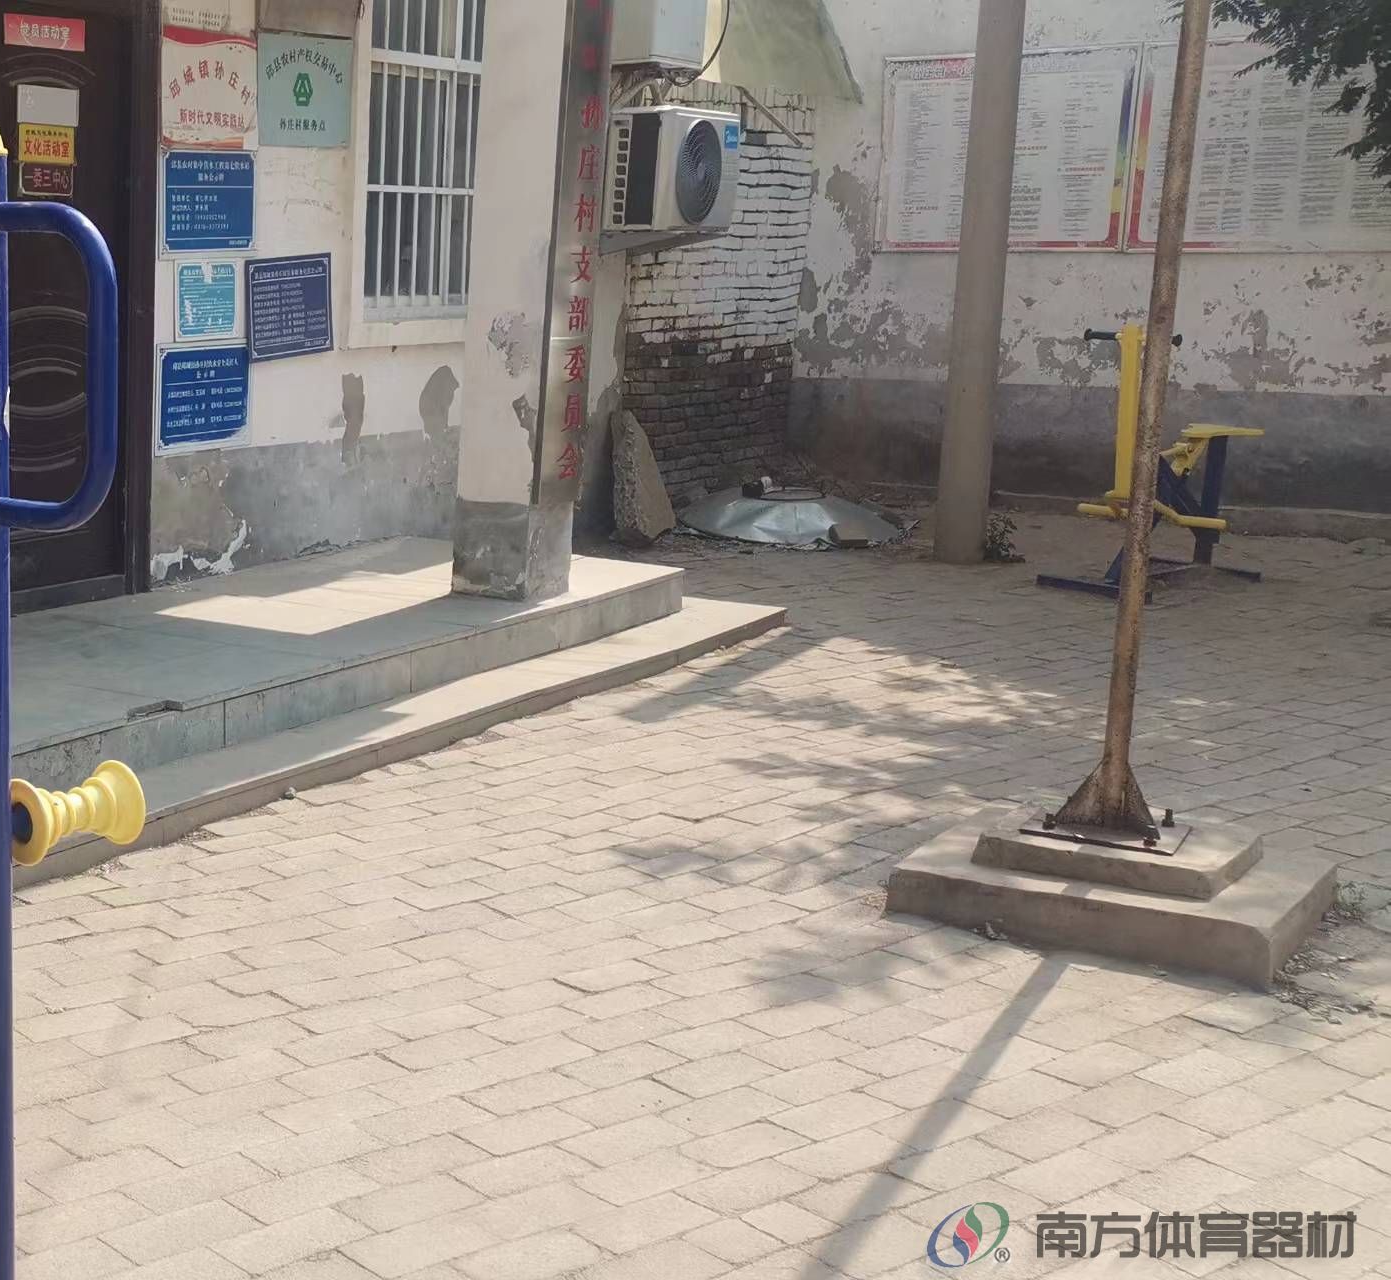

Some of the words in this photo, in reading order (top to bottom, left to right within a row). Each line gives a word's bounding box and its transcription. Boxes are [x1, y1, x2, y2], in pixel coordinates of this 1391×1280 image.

[19, 22, 70, 40] 党员活动室
[265, 47, 344, 88] 邱县农村产权交易中心
[23, 138, 70, 157] 文化活动室
